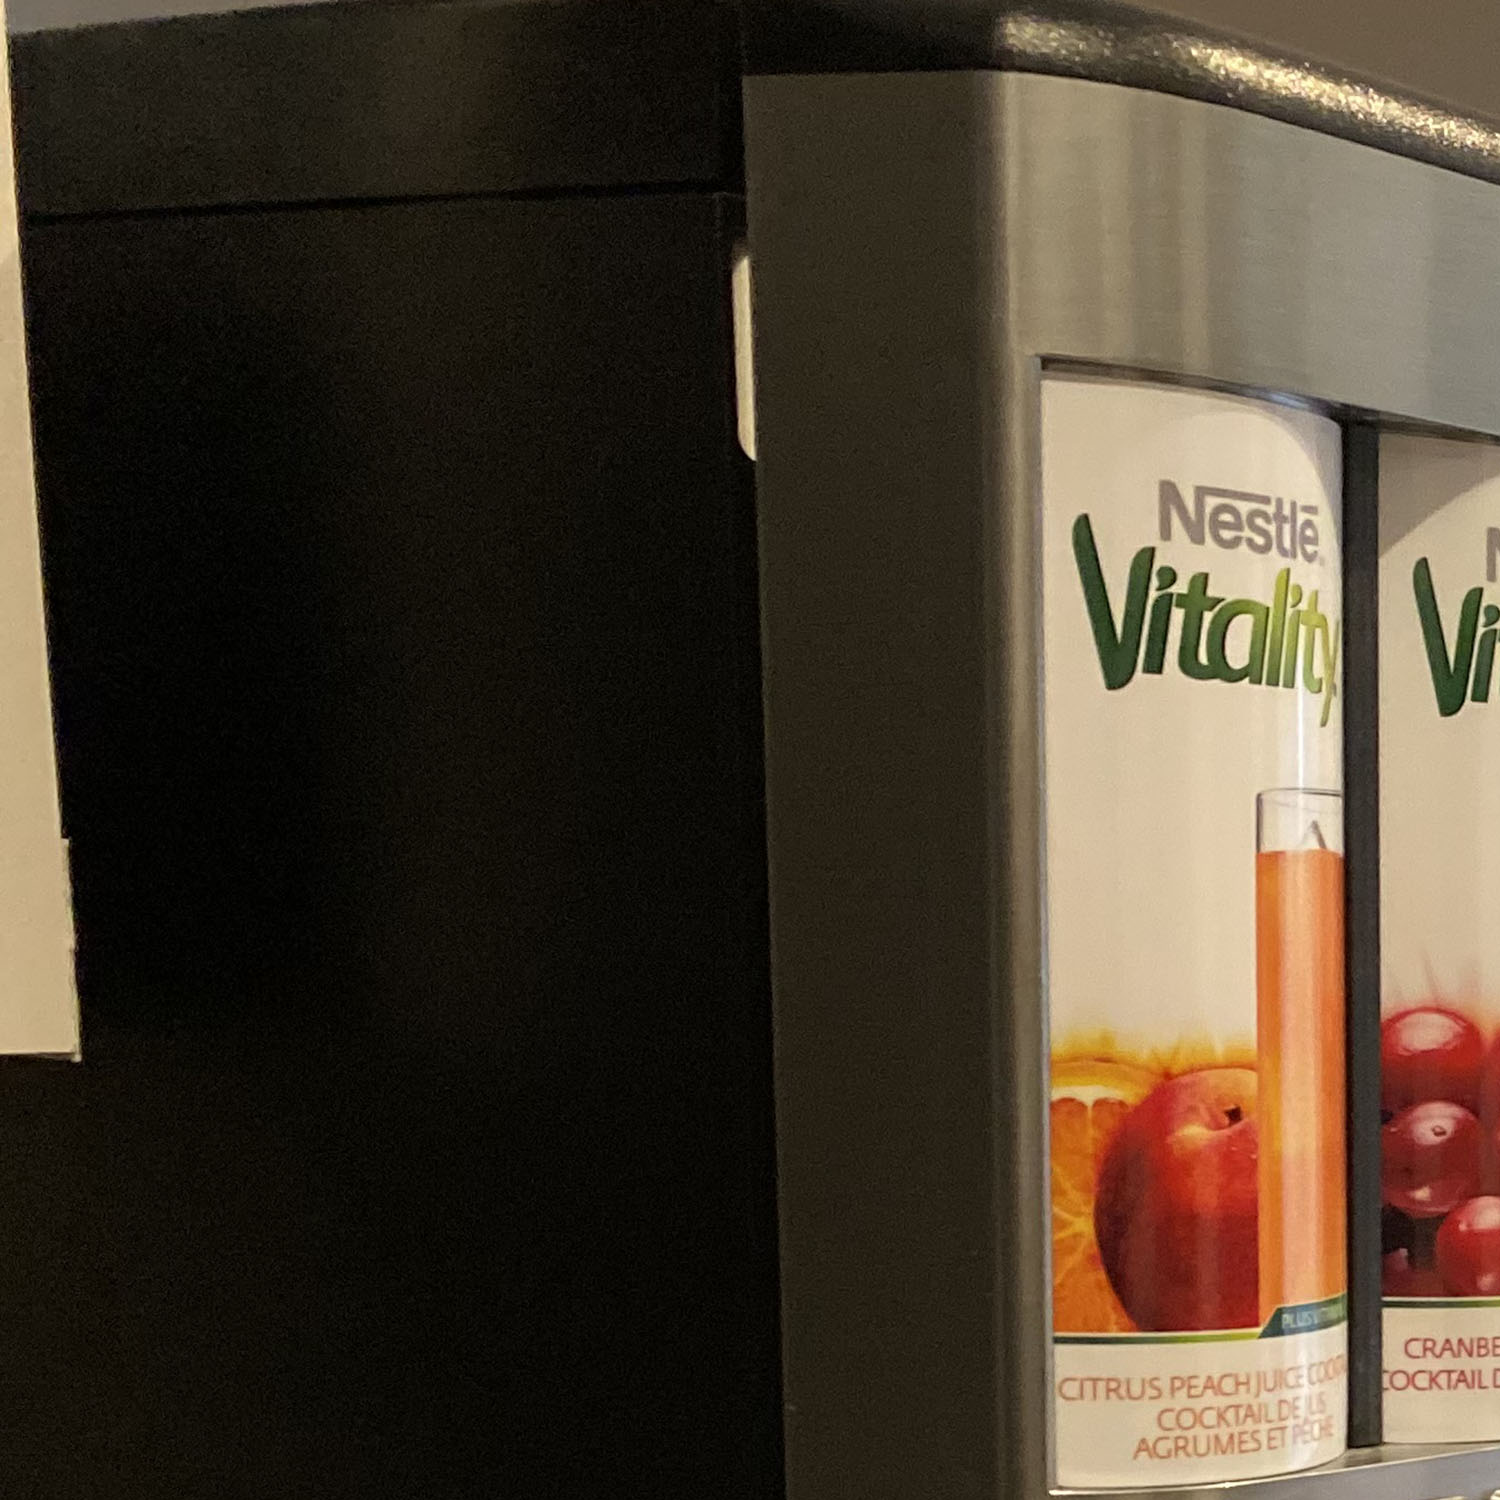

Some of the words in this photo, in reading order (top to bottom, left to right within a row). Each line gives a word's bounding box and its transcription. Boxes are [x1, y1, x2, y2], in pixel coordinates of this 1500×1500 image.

[1072, 512, 1340, 728] Vitality
[1058, 1375, 1162, 1401] CITRUS
[1169, 1372, 1252, 1398] PEACH
[1254, 1366, 1305, 1397] JUICE
[1156, 1402, 1277, 1432] COCKTAIL
[1278, 1397, 1302, 1421] DE
[1133, 1429, 1262, 1461] AGRUMES
[1266, 1426, 1288, 1451] ET
